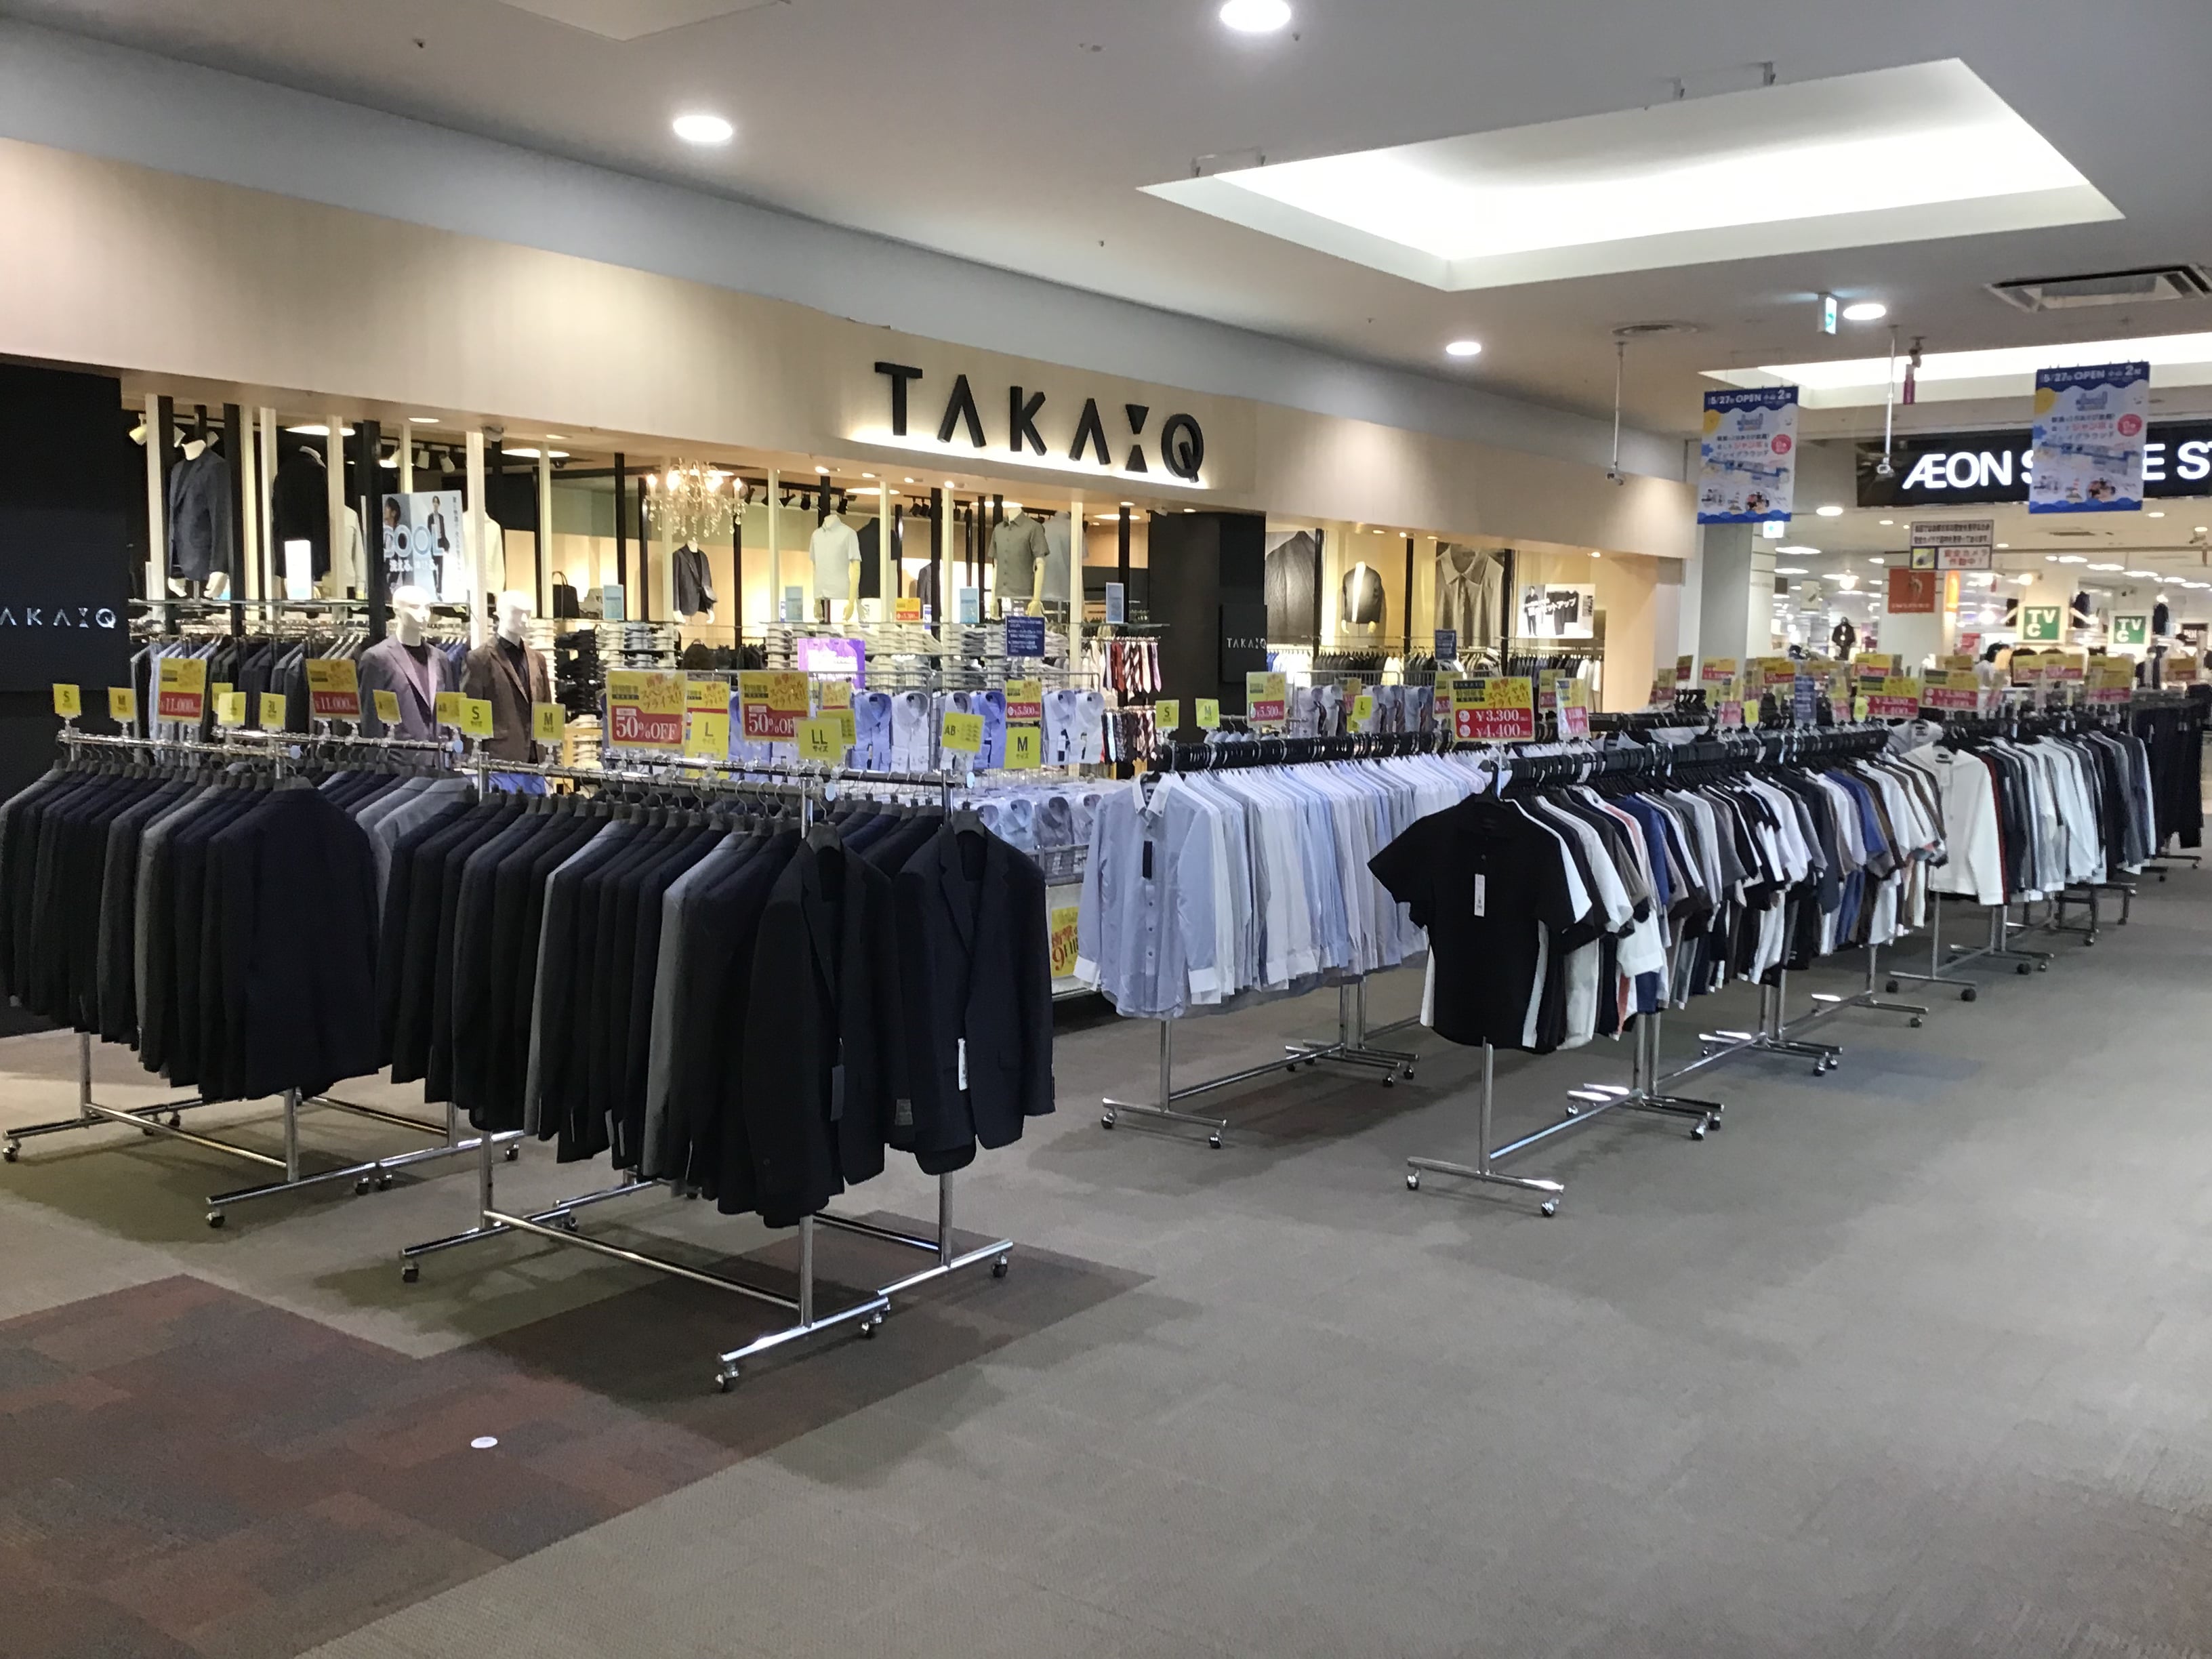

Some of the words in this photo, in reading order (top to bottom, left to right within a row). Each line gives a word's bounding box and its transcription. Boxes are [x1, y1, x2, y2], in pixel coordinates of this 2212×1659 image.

[2074, 369, 2105, 380] OPEN
[1736, 393, 1762, 403] OPEN
[472, 706, 480, 720] S
[544, 712, 553, 726] M
[1164, 707, 1170, 717] S
[616, 716, 677, 740] 50%OFF
[705, 722, 714, 737] L
[944, 725, 956, 735] AB
[811, 729, 828, 745] LL
[1017, 737, 1028, 752] M
